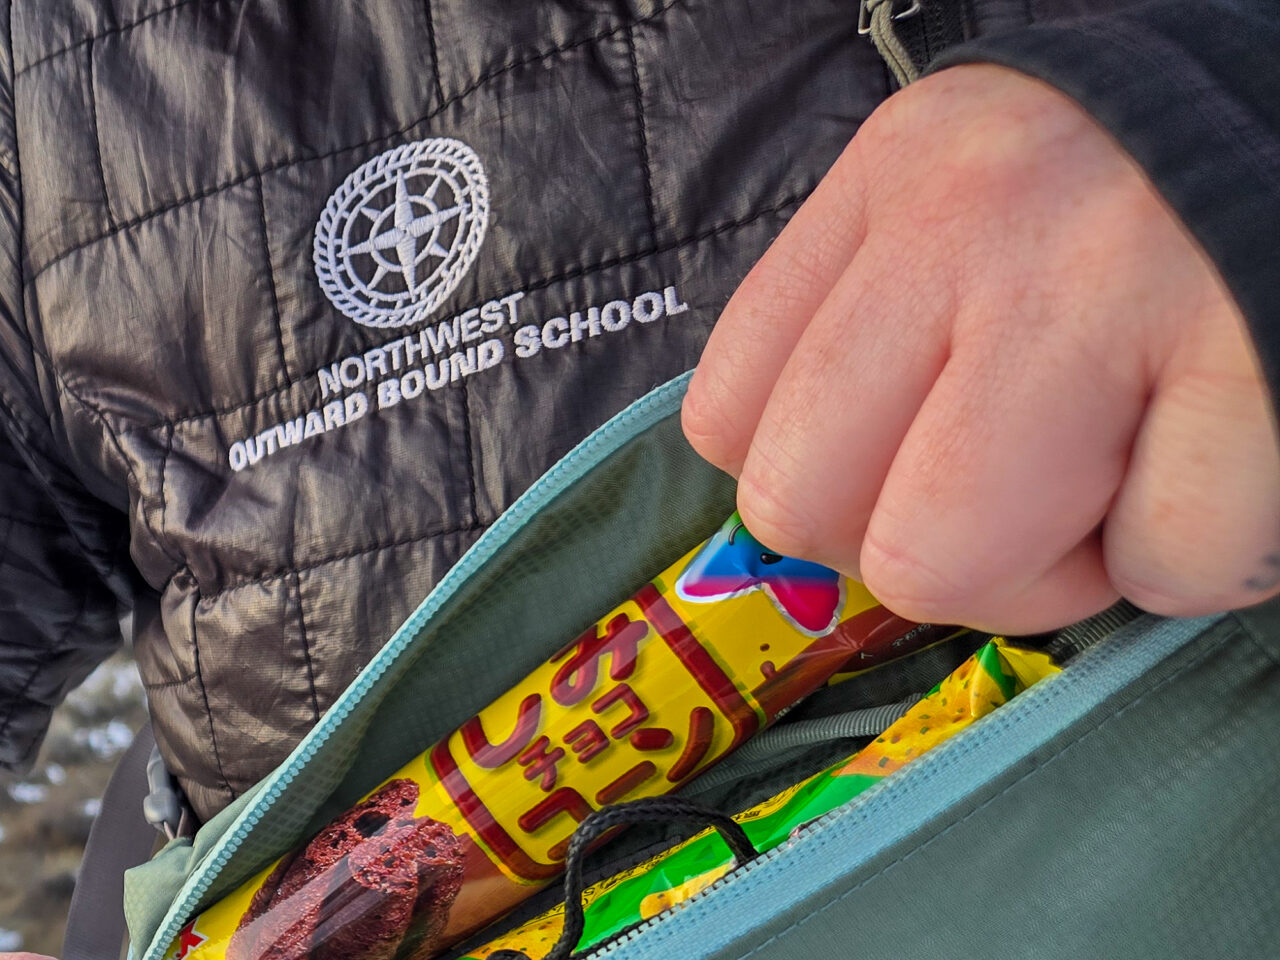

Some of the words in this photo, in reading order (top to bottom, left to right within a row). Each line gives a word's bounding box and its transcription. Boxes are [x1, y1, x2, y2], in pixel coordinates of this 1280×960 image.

[228, 391, 368, 473] OUTWARD
[377, 338, 505, 411] BOUND
[514, 286, 689, 358] SCHOOL
[317, 291, 525, 400] NORTHWEST
[459, 613, 651, 769] しみ
[518, 683, 650, 793] チョコ
[517, 706, 715, 861] コーン
